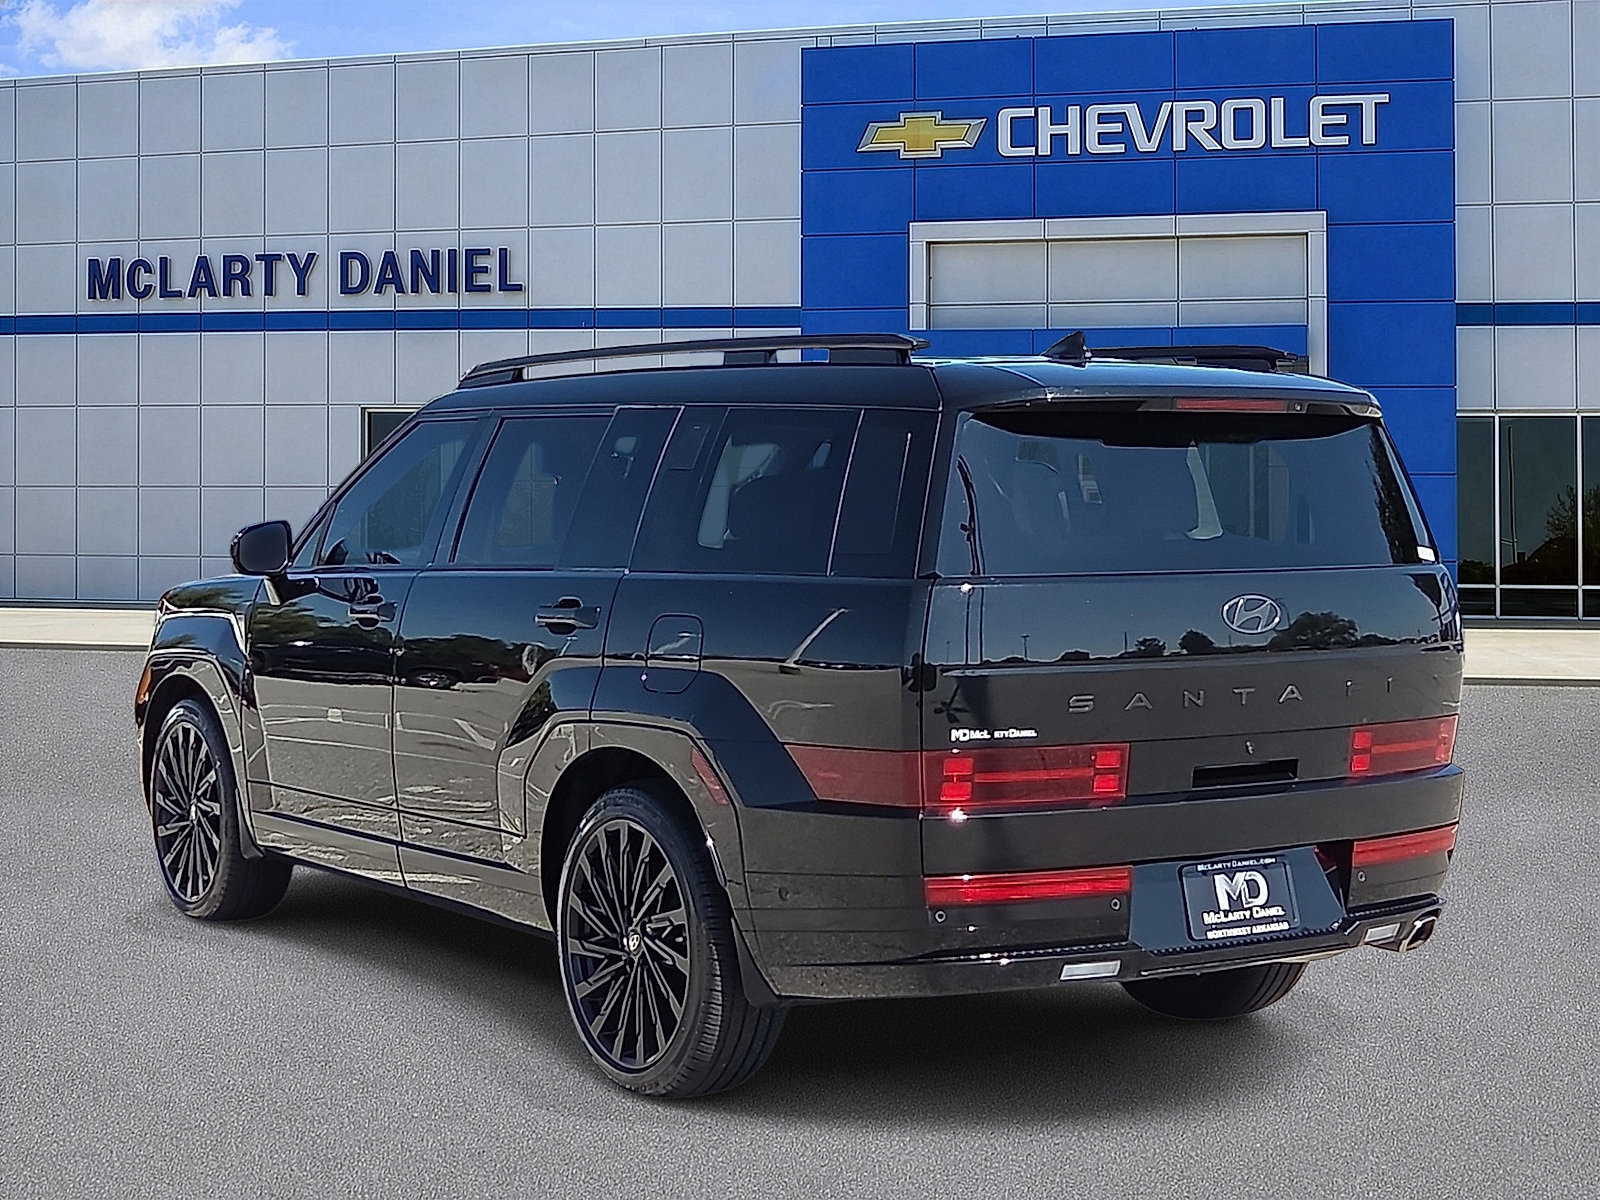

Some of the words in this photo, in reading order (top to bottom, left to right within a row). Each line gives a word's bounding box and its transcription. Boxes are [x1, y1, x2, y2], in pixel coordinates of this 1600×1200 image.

[996, 93, 1390, 157] CHEVROLET
[339, 246, 525, 296] DANIEL
[1068, 684, 1304, 714] SANTA
[1214, 870, 1268, 911] MD
